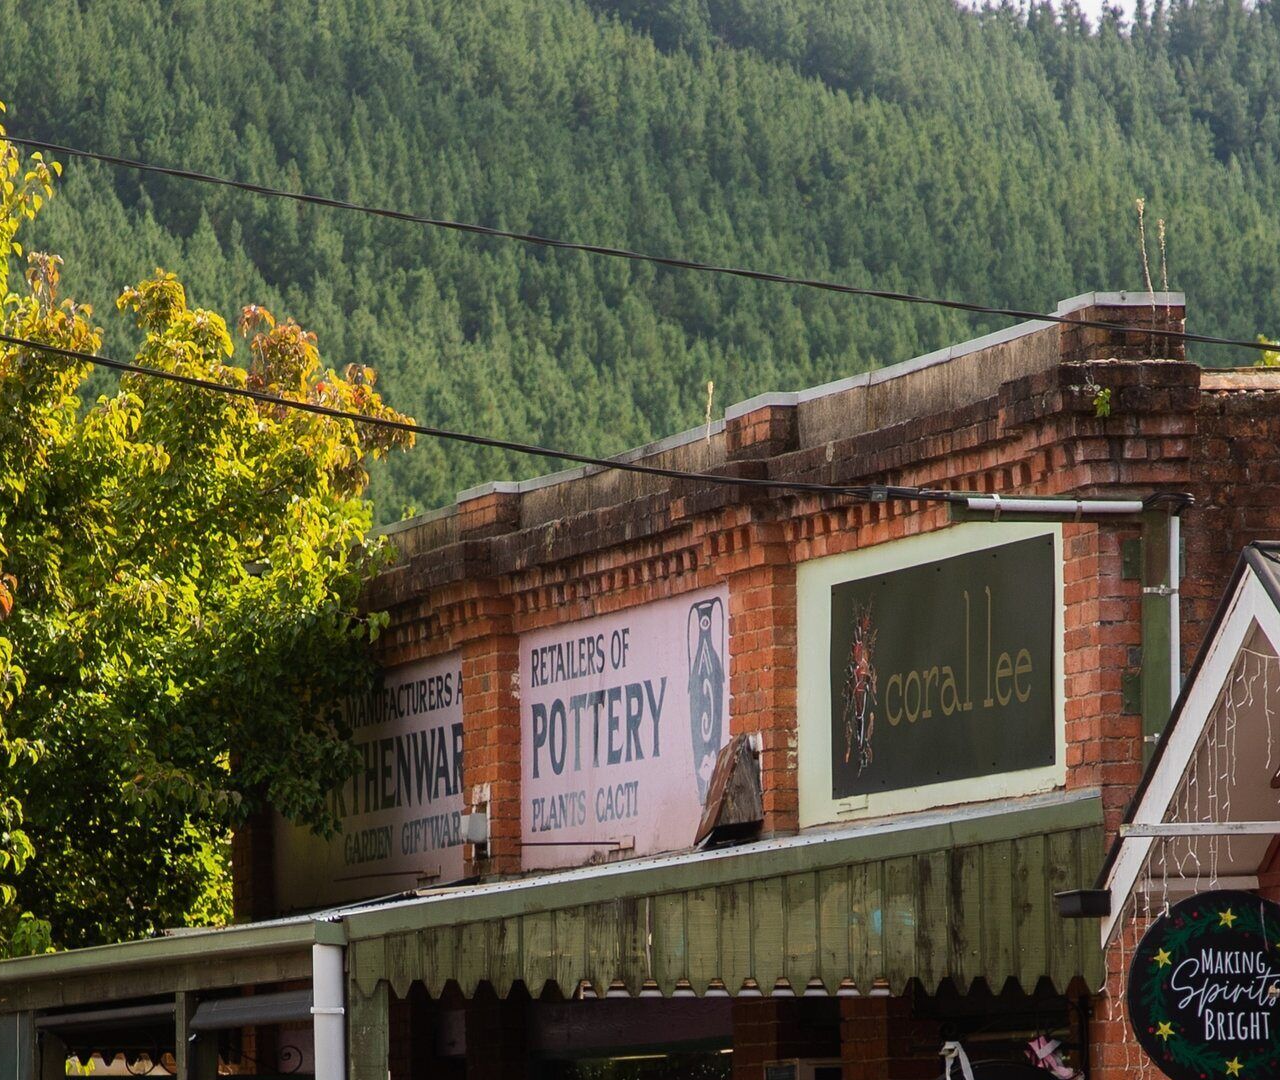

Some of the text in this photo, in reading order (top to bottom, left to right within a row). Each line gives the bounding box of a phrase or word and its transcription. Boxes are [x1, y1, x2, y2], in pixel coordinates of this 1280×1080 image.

[531, 627, 630, 688] RETAILERS OF
[886, 585, 1033, 726] coral lee
[345, 673, 452, 729] MANUFACTURERS
[531, 676, 667, 779] POTTERY
[531, 780, 639, 833] PLANTS CACTI
[344, 810, 464, 866] GARDEN GIFTWAR
[1201, 948, 1266, 975] MAKING
[1205, 1008, 1270, 1041] BRIGHT
